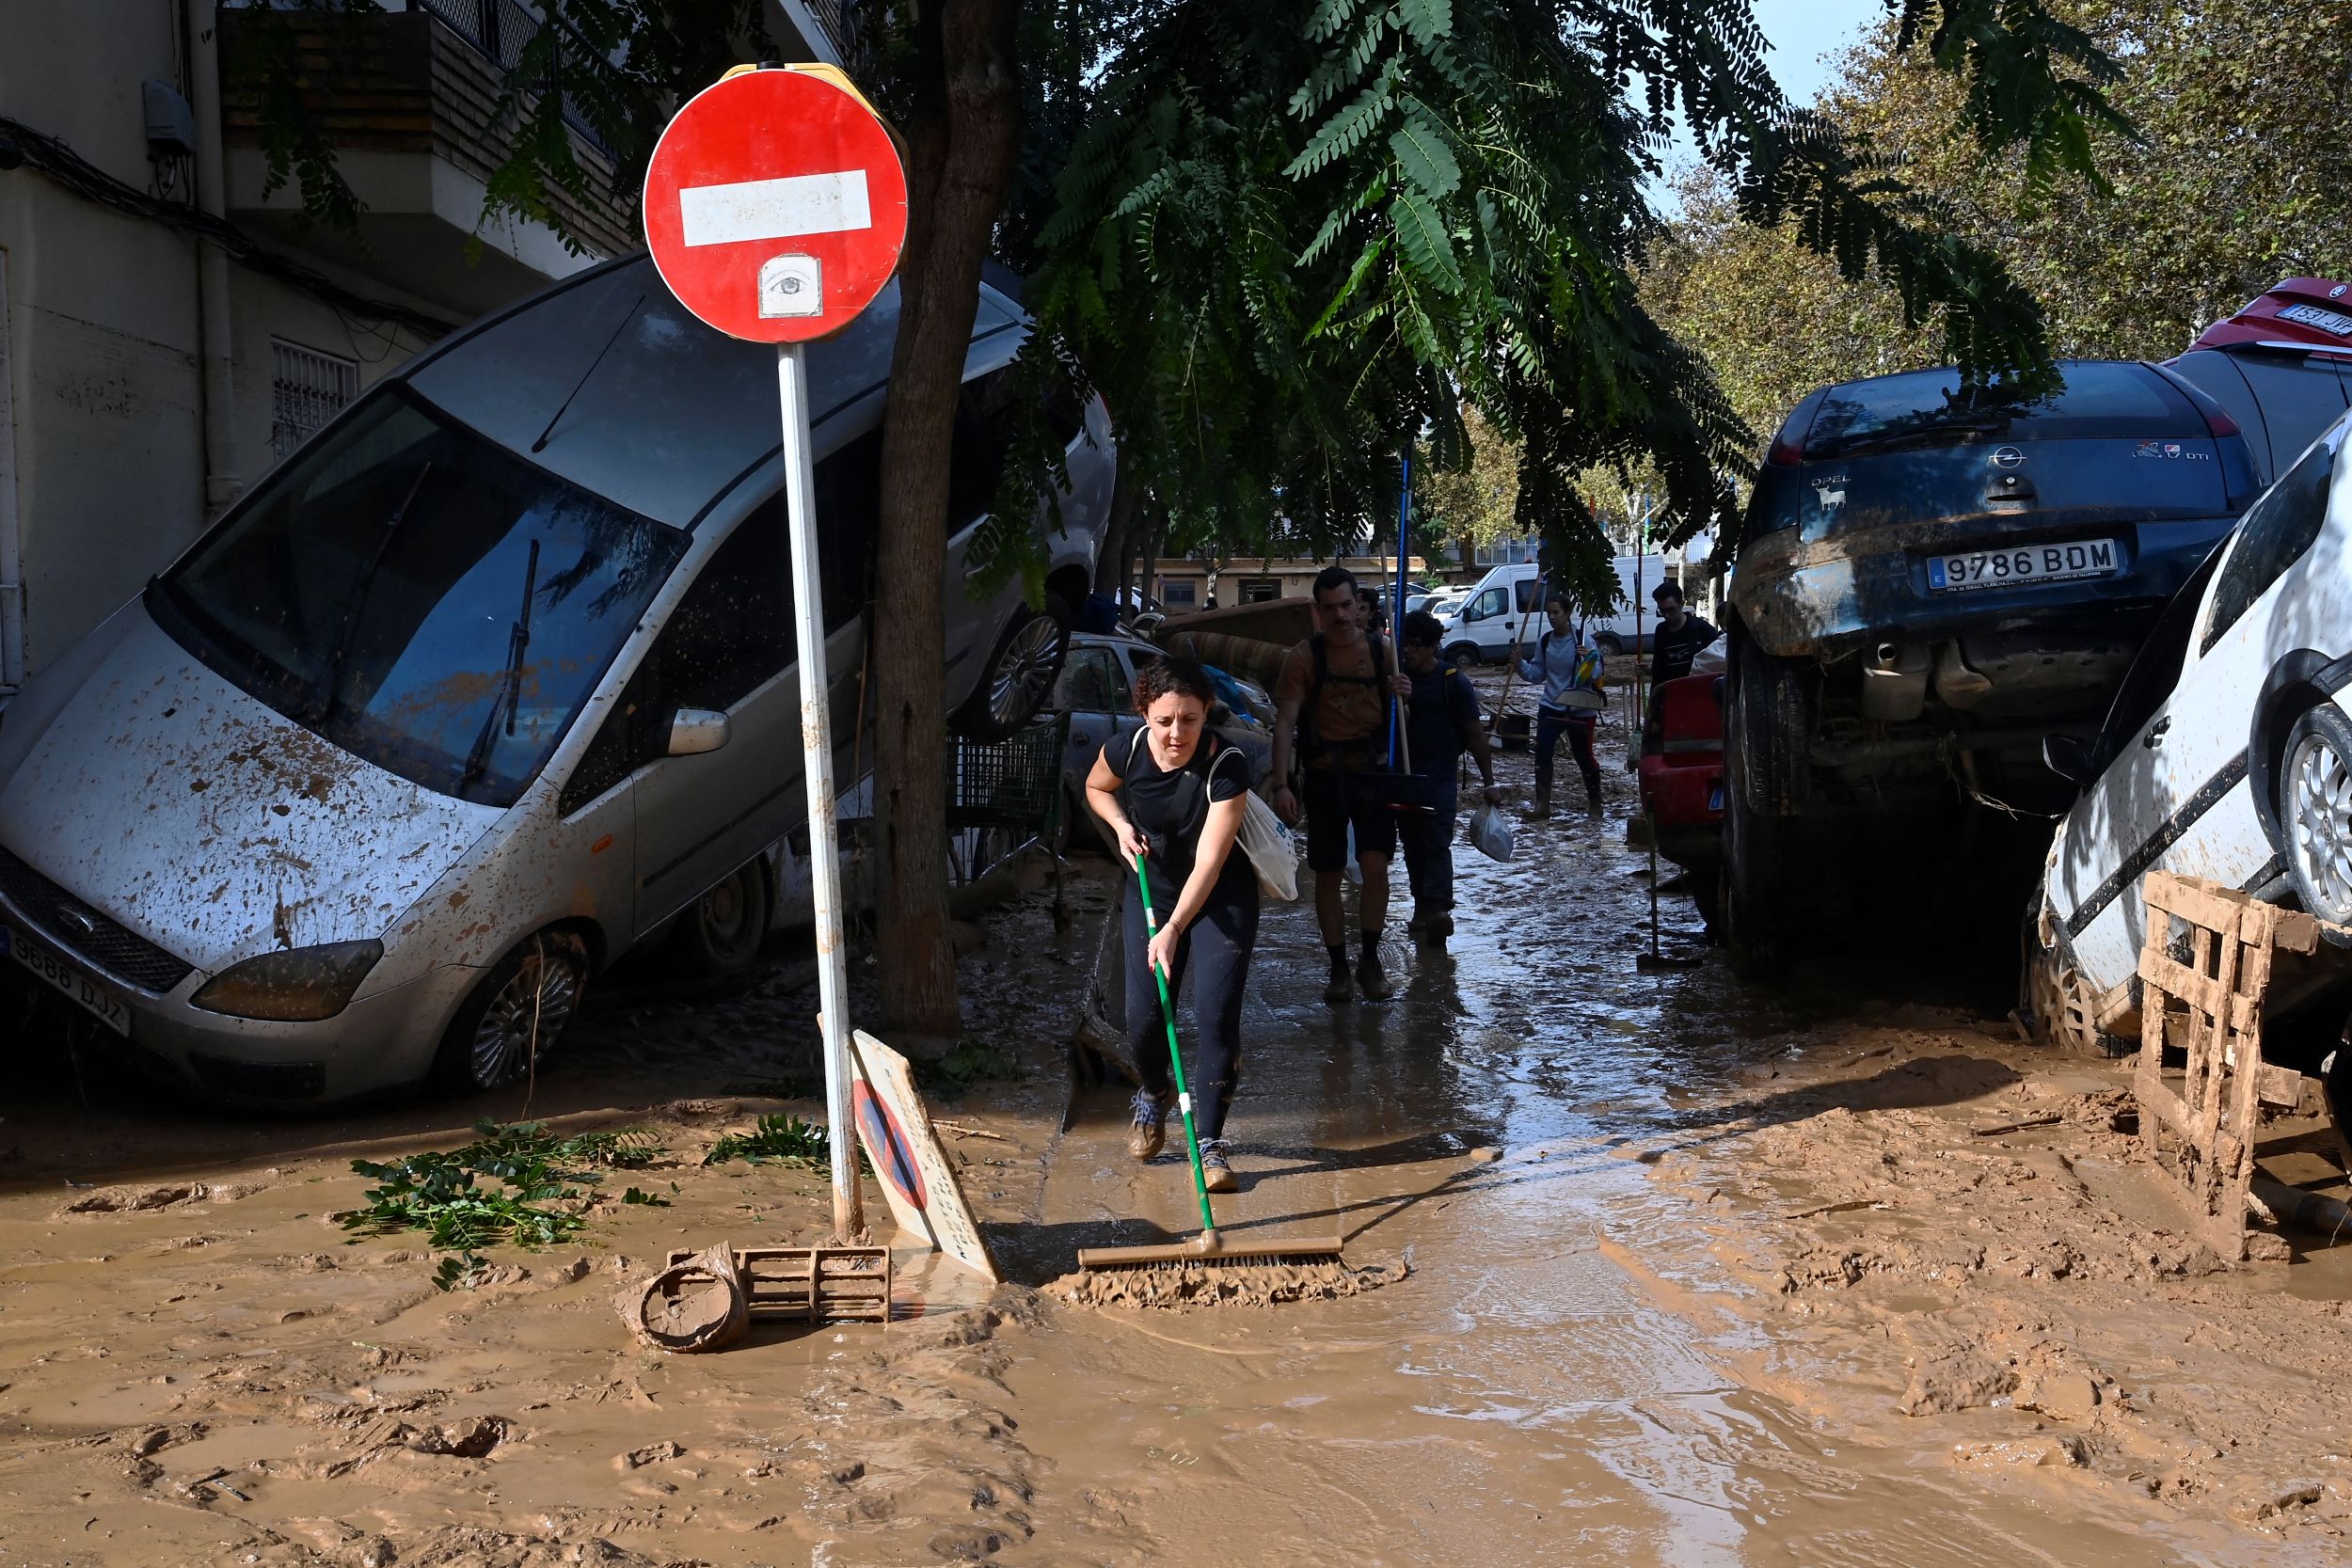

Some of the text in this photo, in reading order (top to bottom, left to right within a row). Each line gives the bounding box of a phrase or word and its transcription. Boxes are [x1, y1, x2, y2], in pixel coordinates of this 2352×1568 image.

[2291, 306, 2328, 322] 1531
[2185, 452, 2209, 461] DTI
[1811, 474, 1851, 486] OPEL
[1947, 543, 2112, 582] 9786 BDM
[1934, 575, 1943, 583] E
[15, 937, 72, 989] 9688
